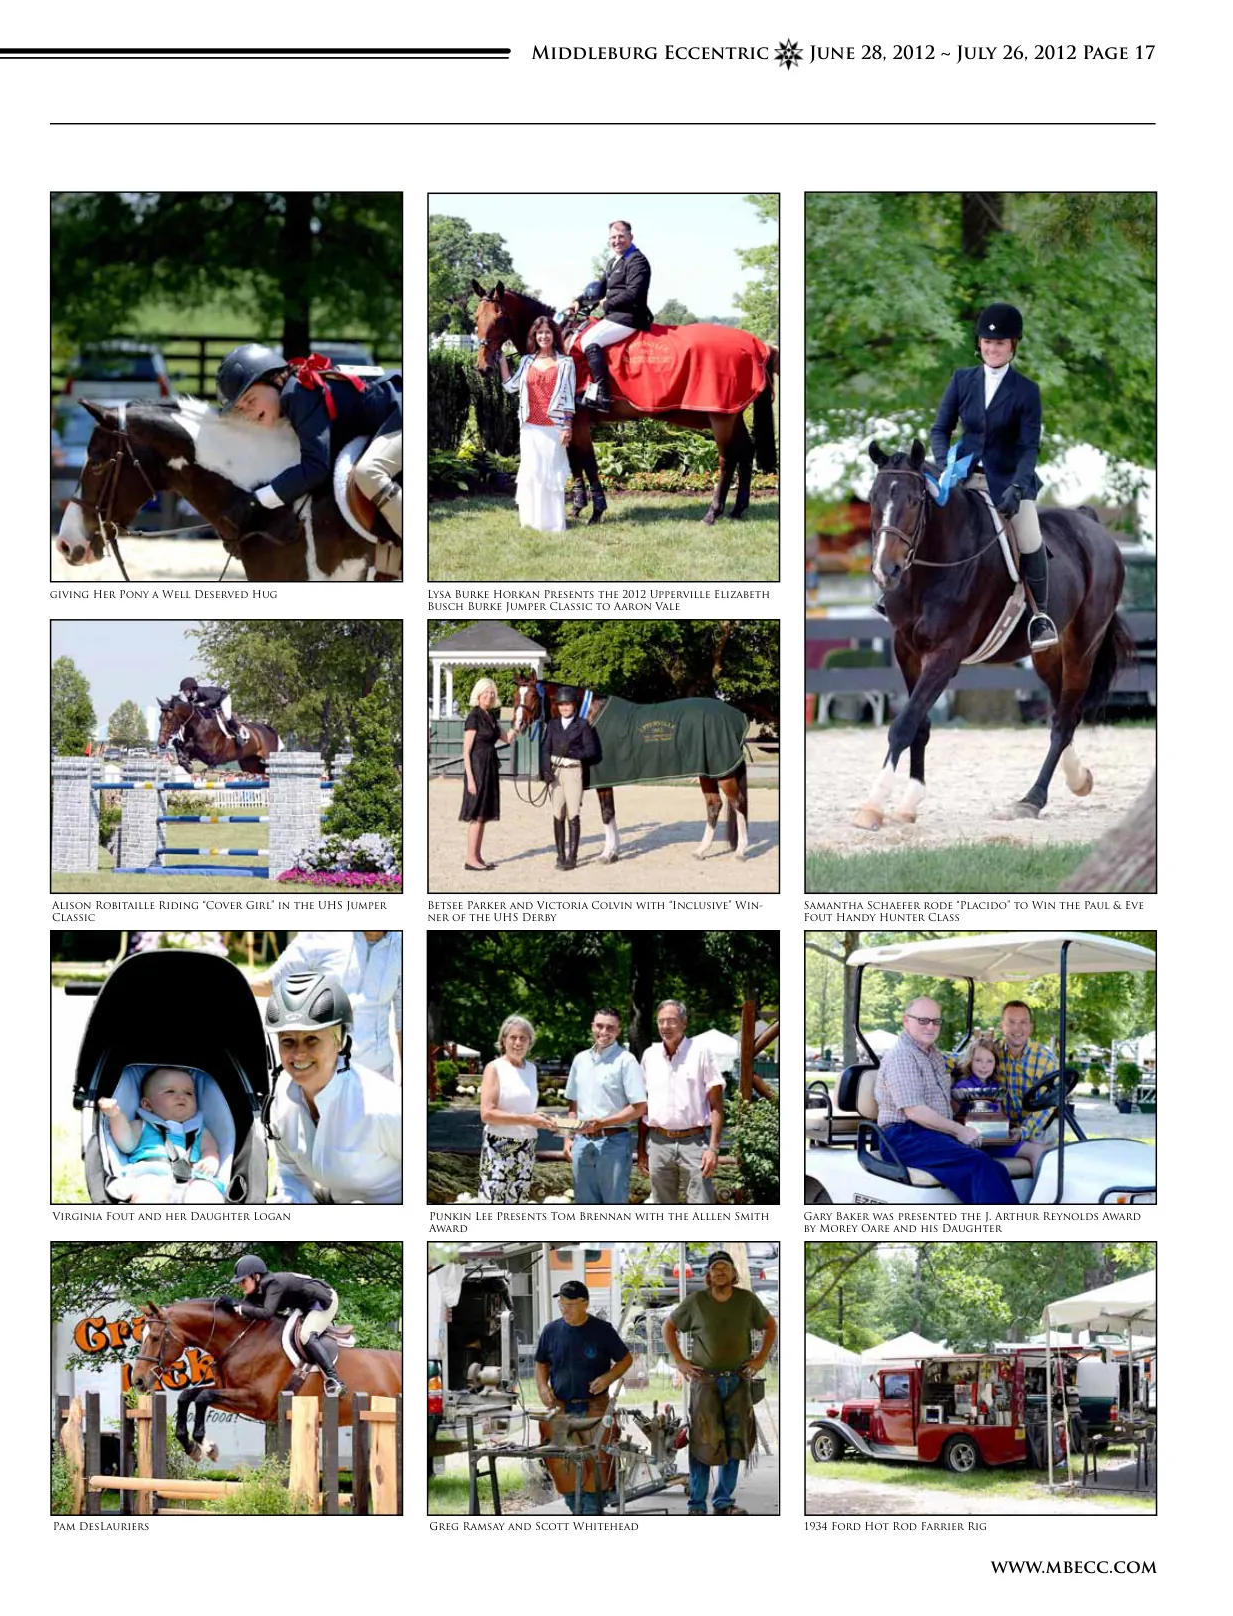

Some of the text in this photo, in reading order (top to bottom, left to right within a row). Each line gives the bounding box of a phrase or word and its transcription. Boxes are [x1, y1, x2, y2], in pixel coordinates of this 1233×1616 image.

[531, 44, 769, 60] MIDDLEBURG ECCENTRIC
[810, 44, 855, 64] JUNE
[861, 44, 887, 61] 28,
[892, 44, 936, 60] 2012
[957, 44, 998, 64] JULY
[1002, 44, 1028, 62] 26,
[1034, 44, 1077, 60] 2012
[1083, 44, 1129, 60] PAGE
[1136, 44, 1156, 60] 17
[49, 589, 277, 599] GIVING HER PONY A WELL DESERVED HUG
[51, 900, 92, 910] ALISON
[95, 900, 156, 910] ROBITAILLE
[159, 900, 199, 910] RIDING
[278, 901, 290, 910] IN
[293, 901, 315, 910] THE
[318, 900, 343, 910] UHS
[346, 900, 388, 912] JUMPER
[804, 900, 864, 910] SAMANTHA
[867, 900, 921, 910] SCHAEFER
[924, 901, 953, 910] RODE
[1013, 901, 1029, 910] TO
[1031, 900, 1056, 910] WIN
[1059, 901, 1080, 910] THE
[1084, 900, 1110, 910] PAUL
[1125, 900, 1144, 910] EVE
[52, 912, 95, 922] CLASSIC
[804, 912, 960, 922] FOUT HANDY HUNTER CLASS
[52, 1211, 291, 1221] VIRGINIA FOUT AND HER DAUGHTER LOGAN
[53, 1521, 150, 1531] PAM DESLAURIERS
[429, 1521, 639, 1531] GREG RAMSAY AND SCOTT WHITEHEAD
[805, 1521, 987, 1531] 1934 FORD HOT ROD FARRIER RIG
[990, 1560, 1157, 1574] WWW.MBECC.COM
